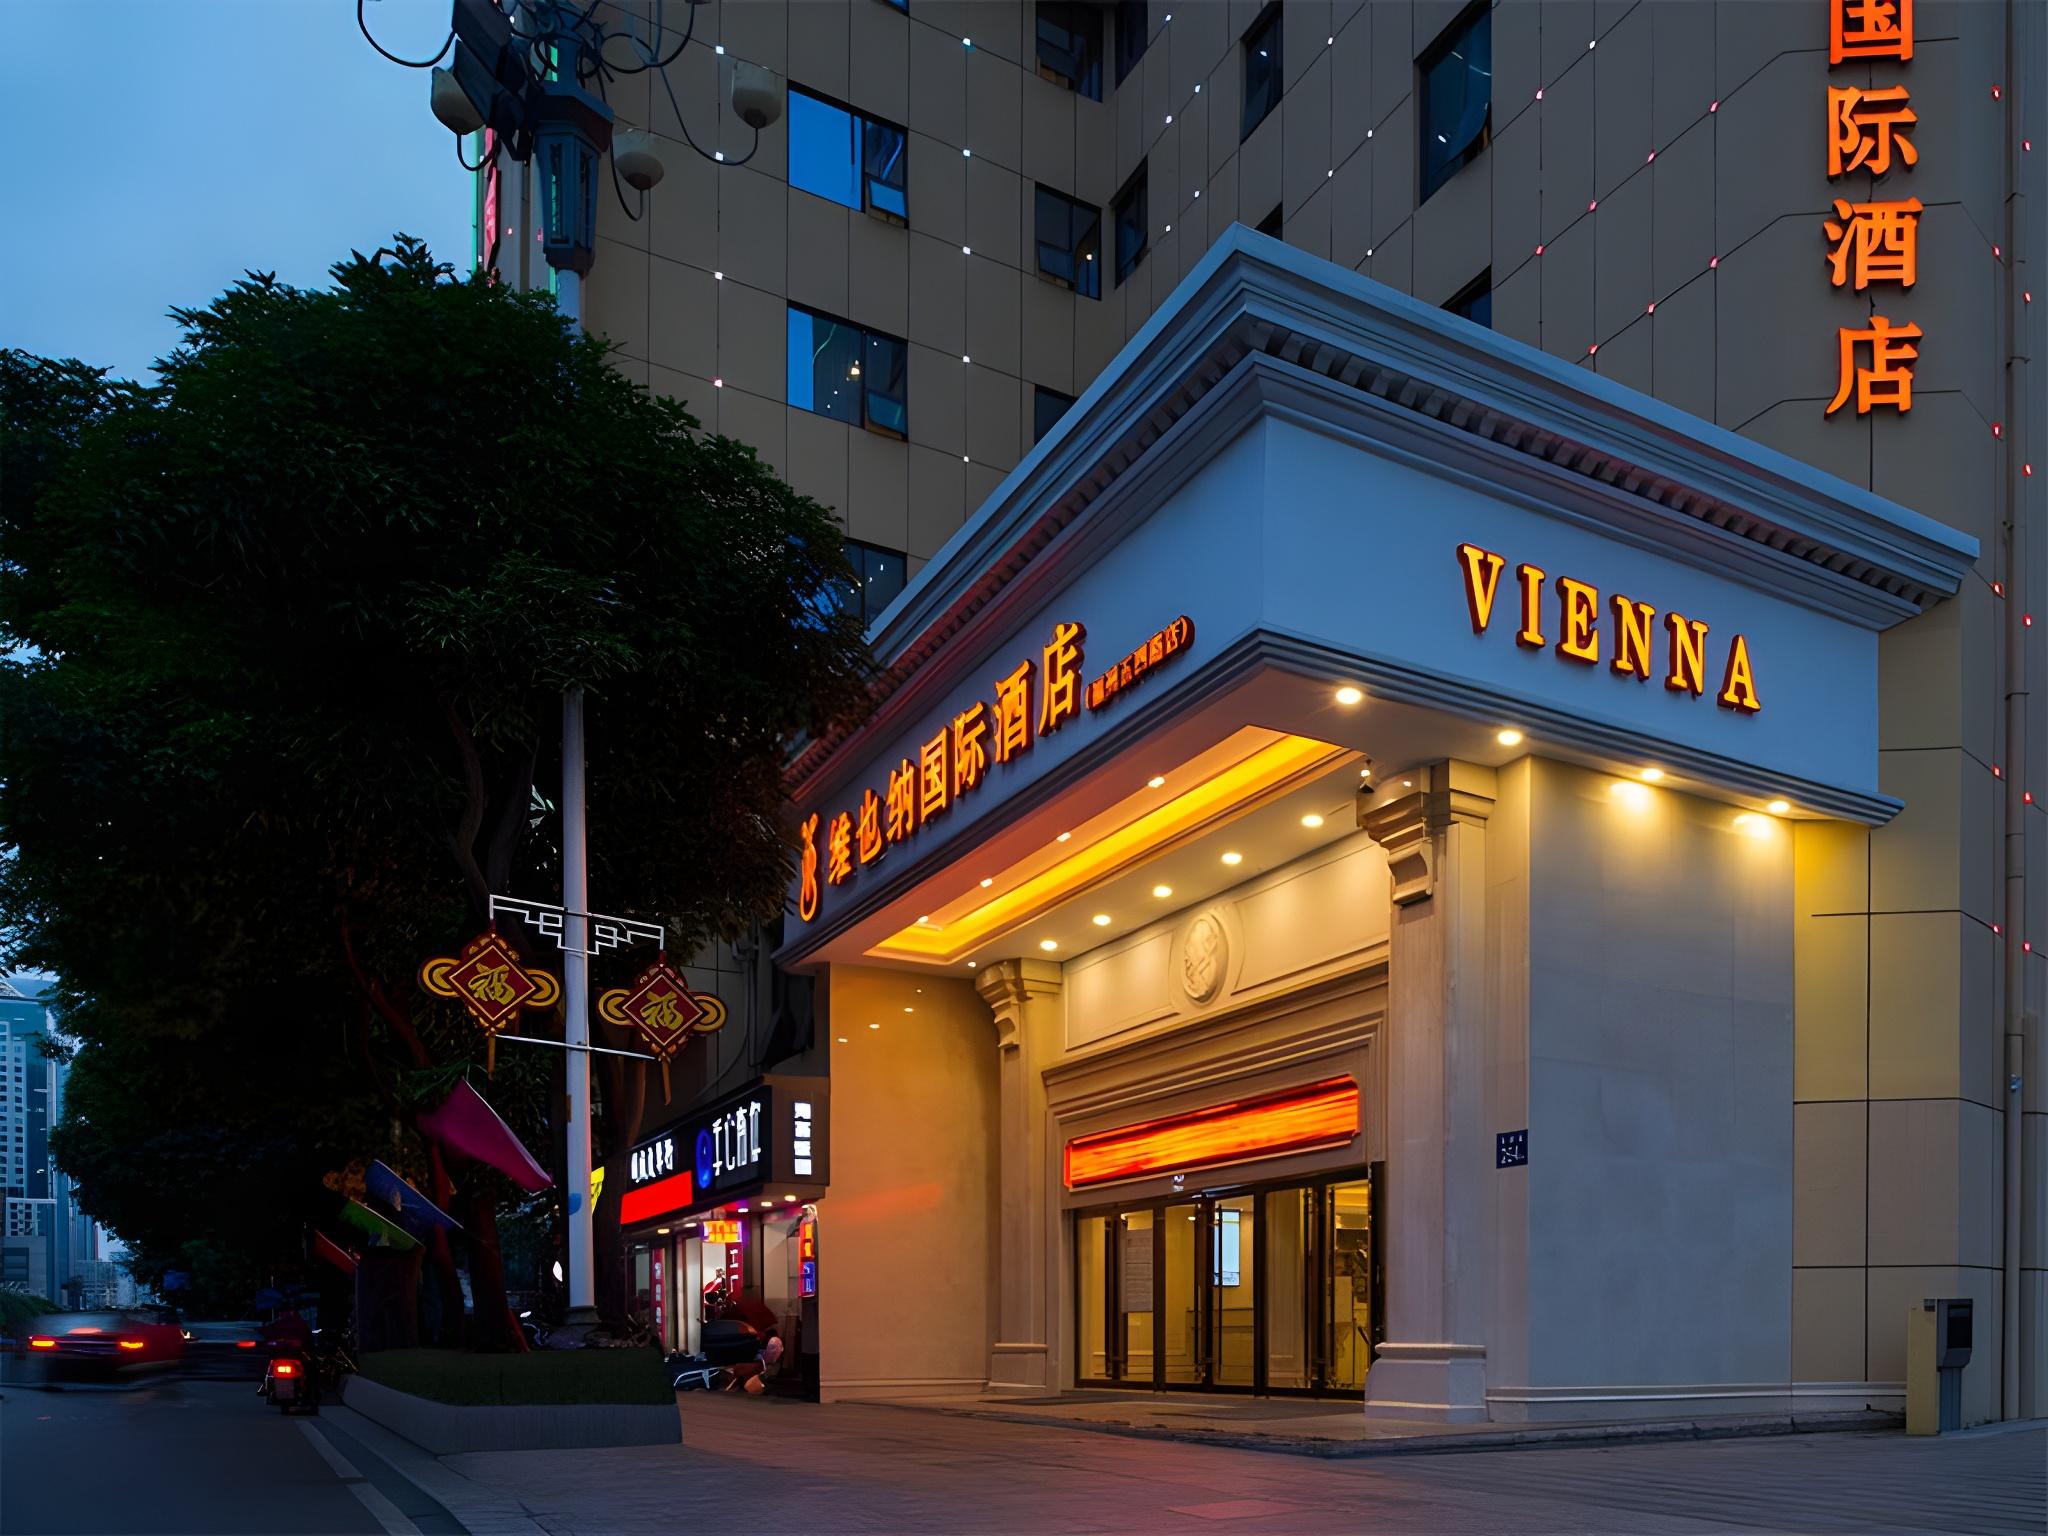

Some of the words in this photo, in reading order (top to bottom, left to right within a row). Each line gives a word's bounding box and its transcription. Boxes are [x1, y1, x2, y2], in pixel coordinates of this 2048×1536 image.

[1824, 0, 1924, 420] 国际酒店
[1457, 543, 1762, 713] VIENNA
[827, 622, 1086, 886] 维也纳国际酒店
[467, 962, 517, 1006] 福
[639, 989, 685, 1031] 福
